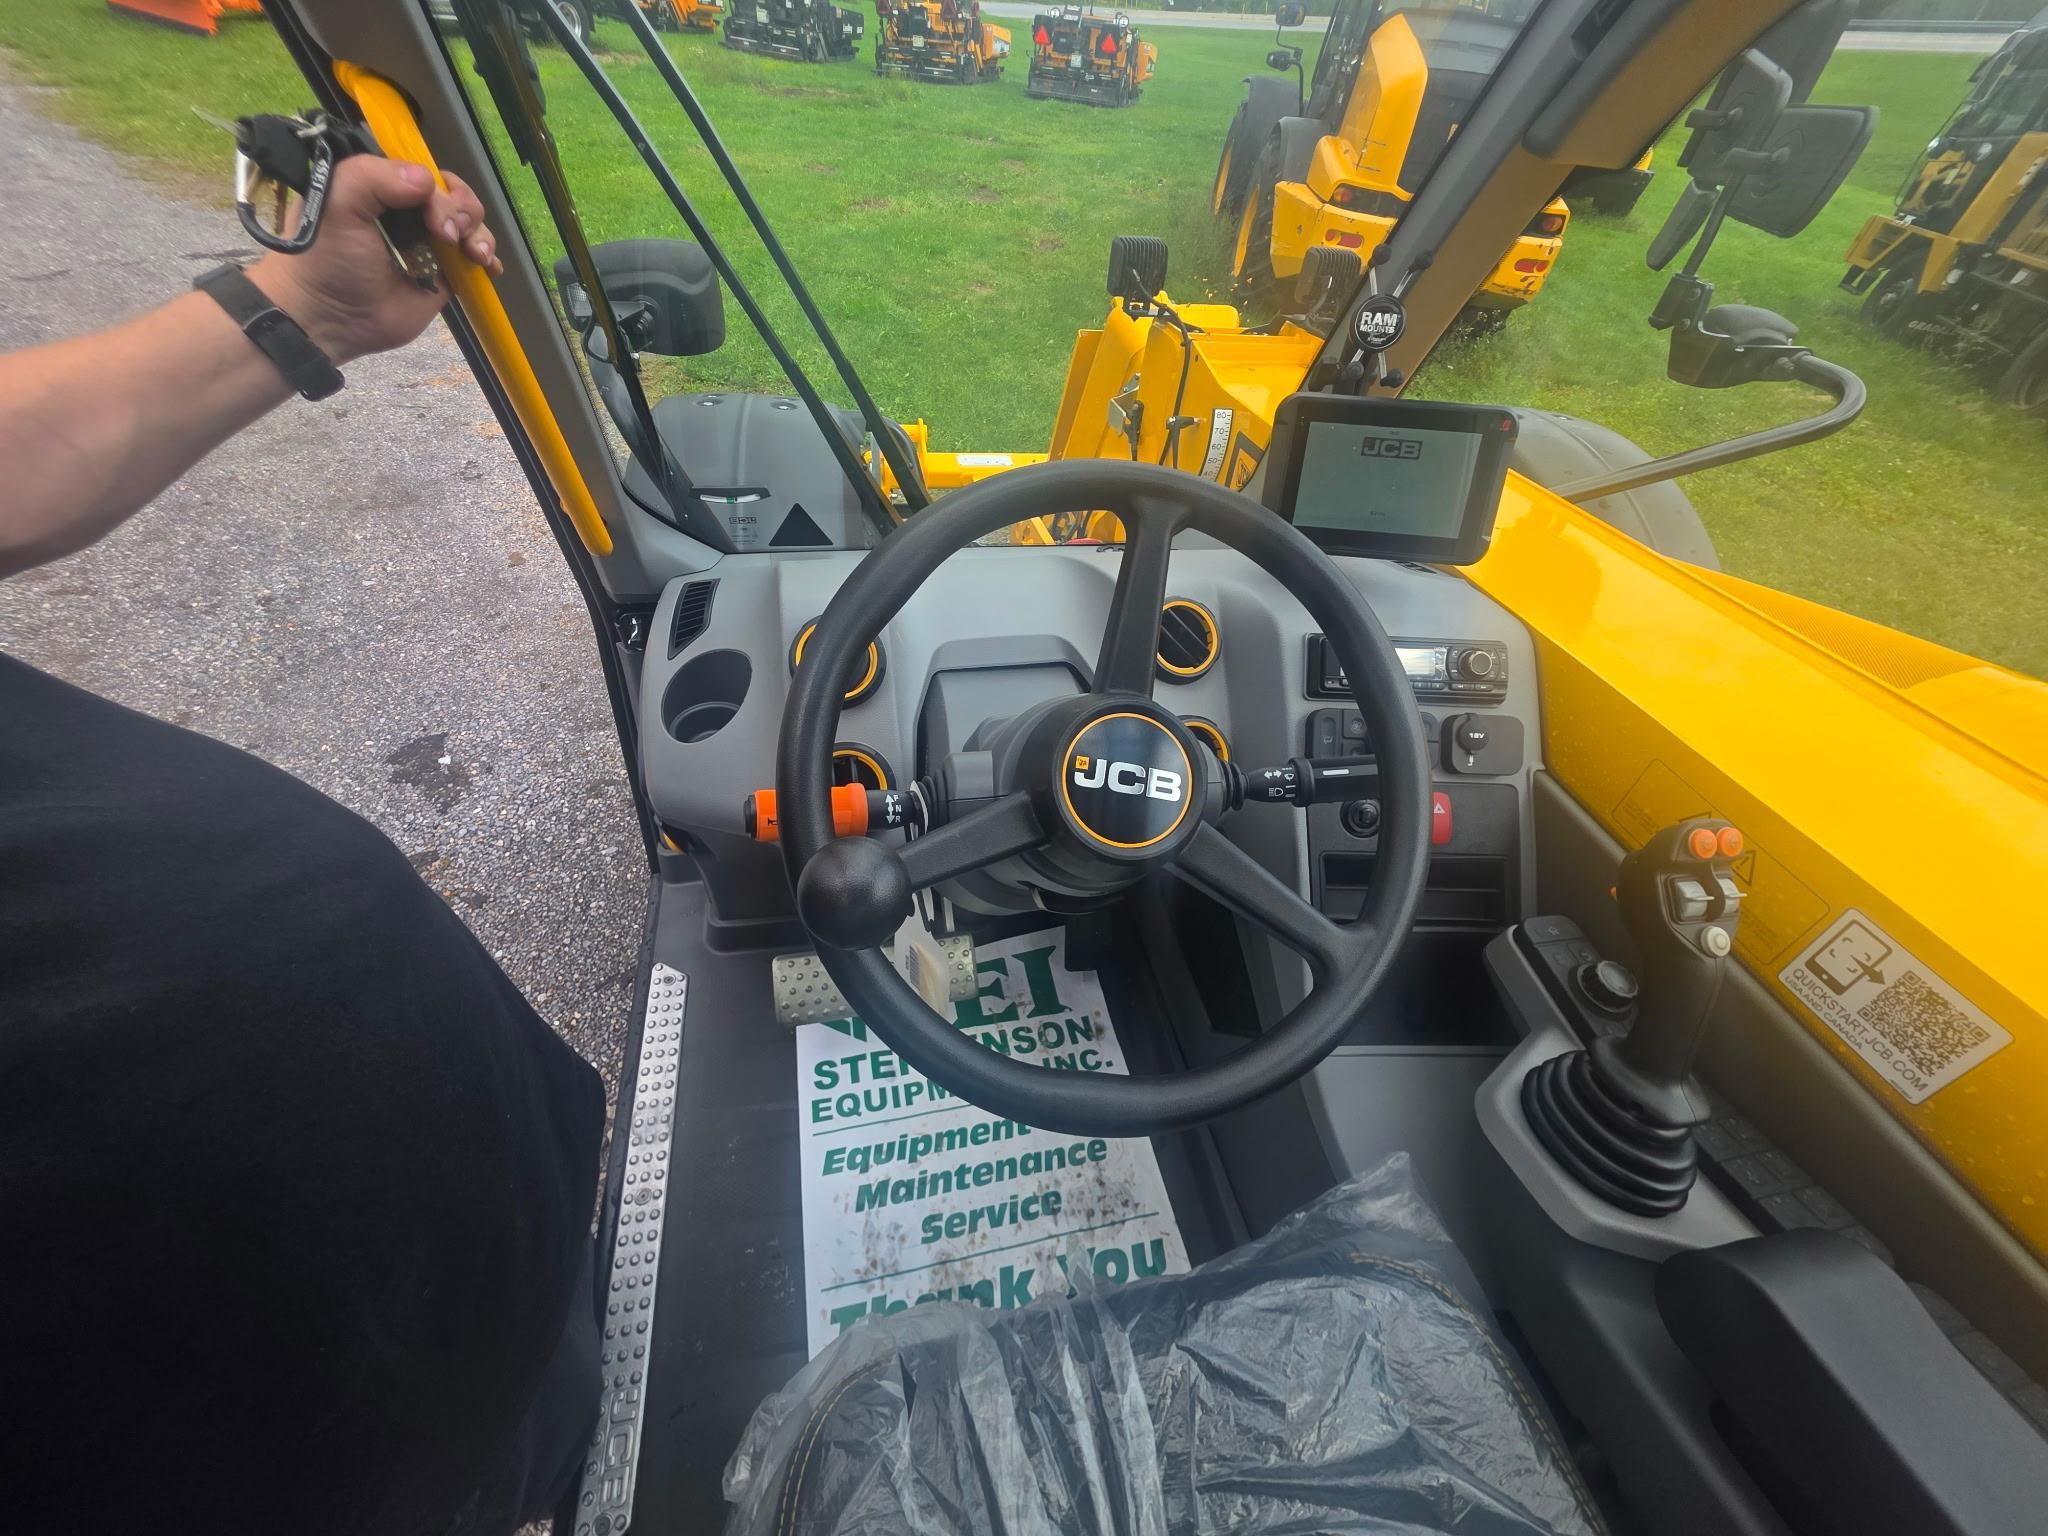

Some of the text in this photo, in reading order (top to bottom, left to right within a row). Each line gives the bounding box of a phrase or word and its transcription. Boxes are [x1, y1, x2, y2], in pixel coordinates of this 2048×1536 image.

[1359, 324, 1396, 334] MOUNTS
[1361, 311, 1398, 326] RAM
[1214, 427, 1225, 435] 70
[1216, 411, 1227, 419] 80
[1363, 437, 1422, 459] JCB
[1074, 756, 1182, 802] JCB
[895, 804, 902, 813] N
[895, 815, 901, 823] R
[1784, 975, 1863, 1050] USA AND CANADA
[1792, 967, 1929, 1092] QUICKSTART.JCB.COM
[822, 1118, 1032, 1177] Equipment
[855, 1138, 1108, 1213] Maintenance
[920, 1190, 1063, 1245] Service
[602, 1388, 638, 1509] JCB
